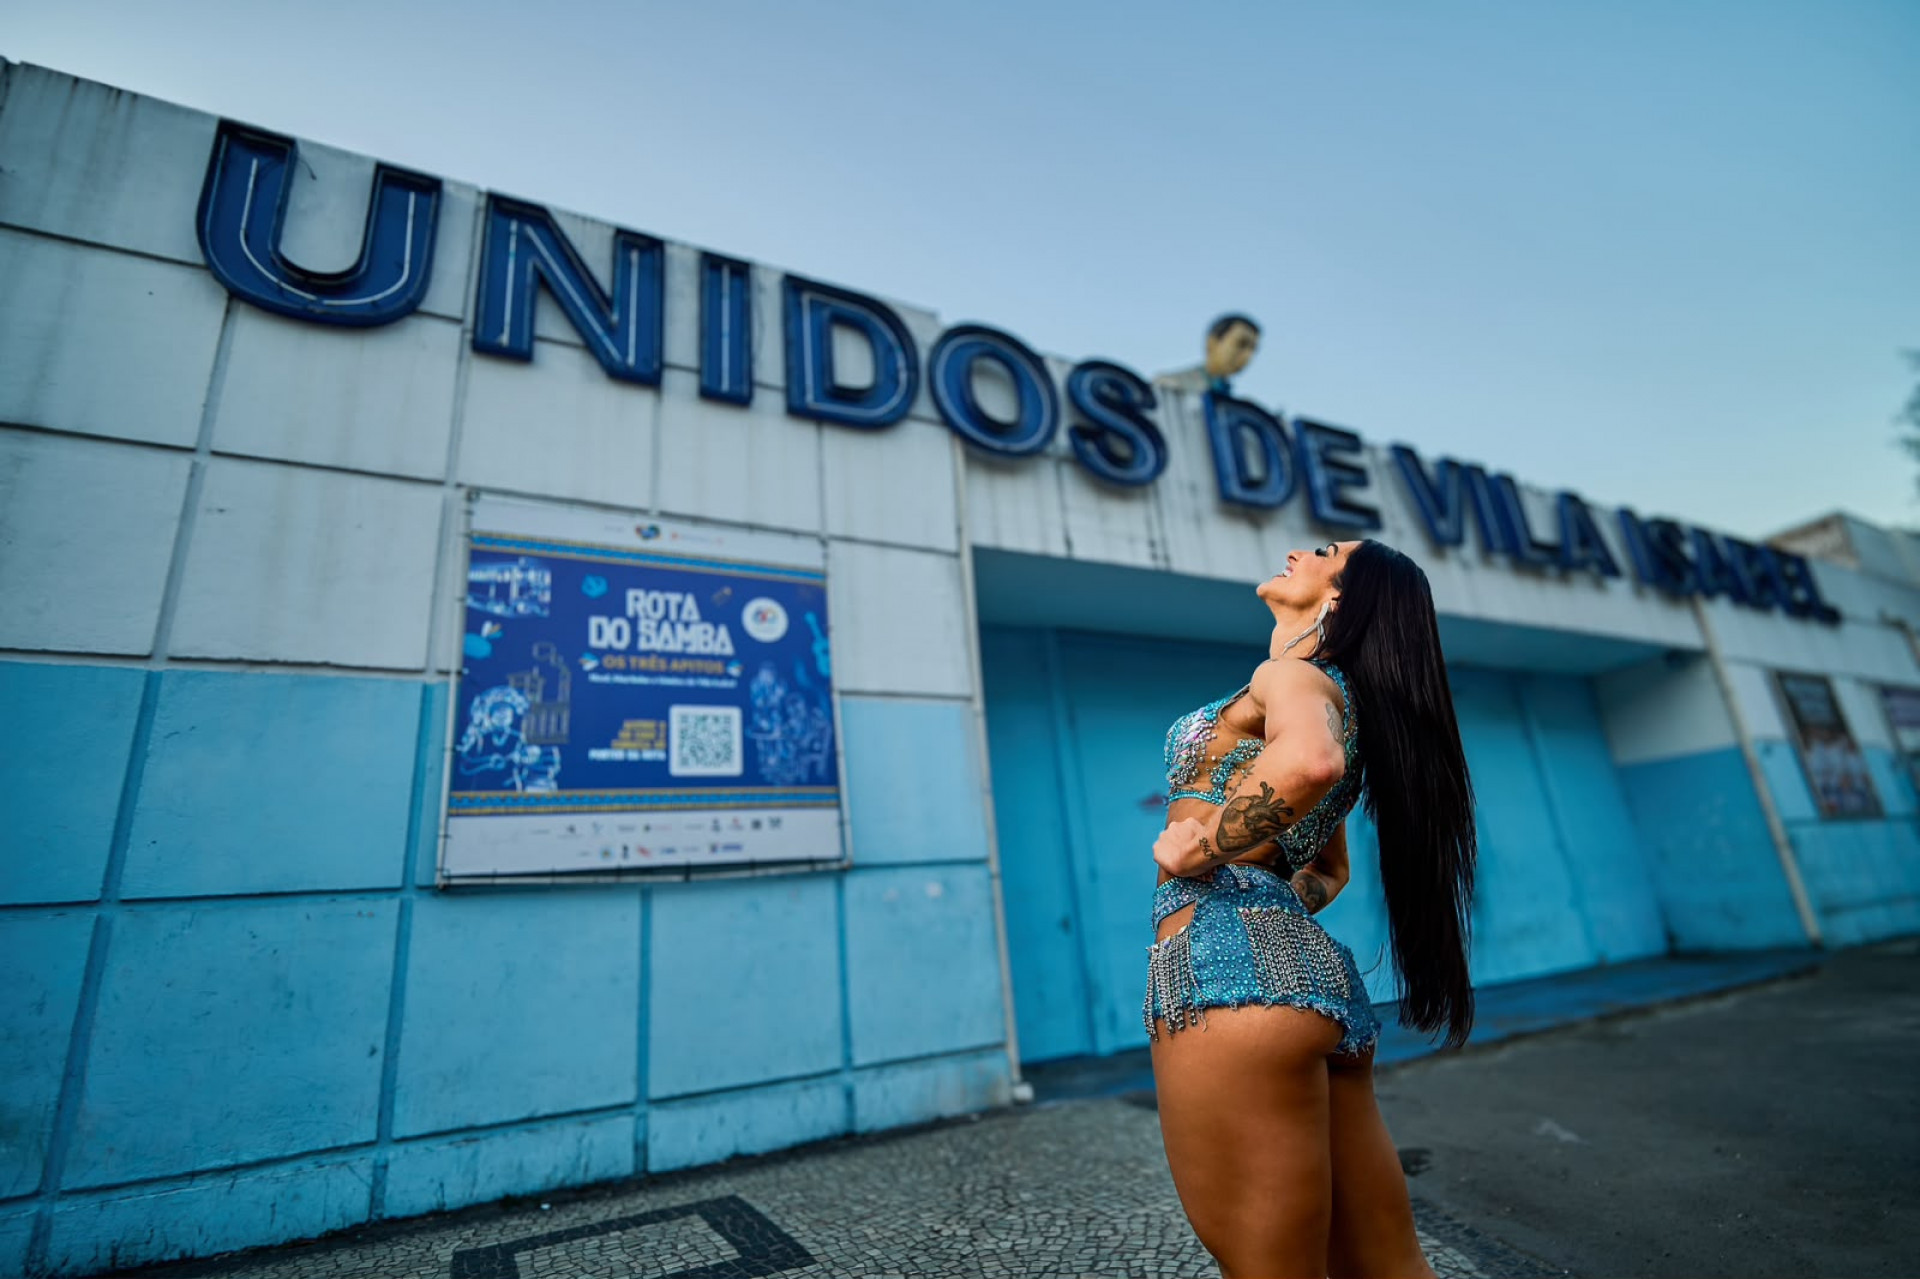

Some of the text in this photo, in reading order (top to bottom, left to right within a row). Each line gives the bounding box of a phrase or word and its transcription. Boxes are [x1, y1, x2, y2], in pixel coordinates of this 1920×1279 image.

[196, 118, 1168, 487] UNIDOS
[1203, 389, 1382, 530] DE
[1391, 442, 1622, 579] VILA
[626, 588, 701, 622] ROTA
[588, 615, 631, 650] DO
[637, 618, 735, 657] SAMBA
[603, 655, 627, 669] OS
